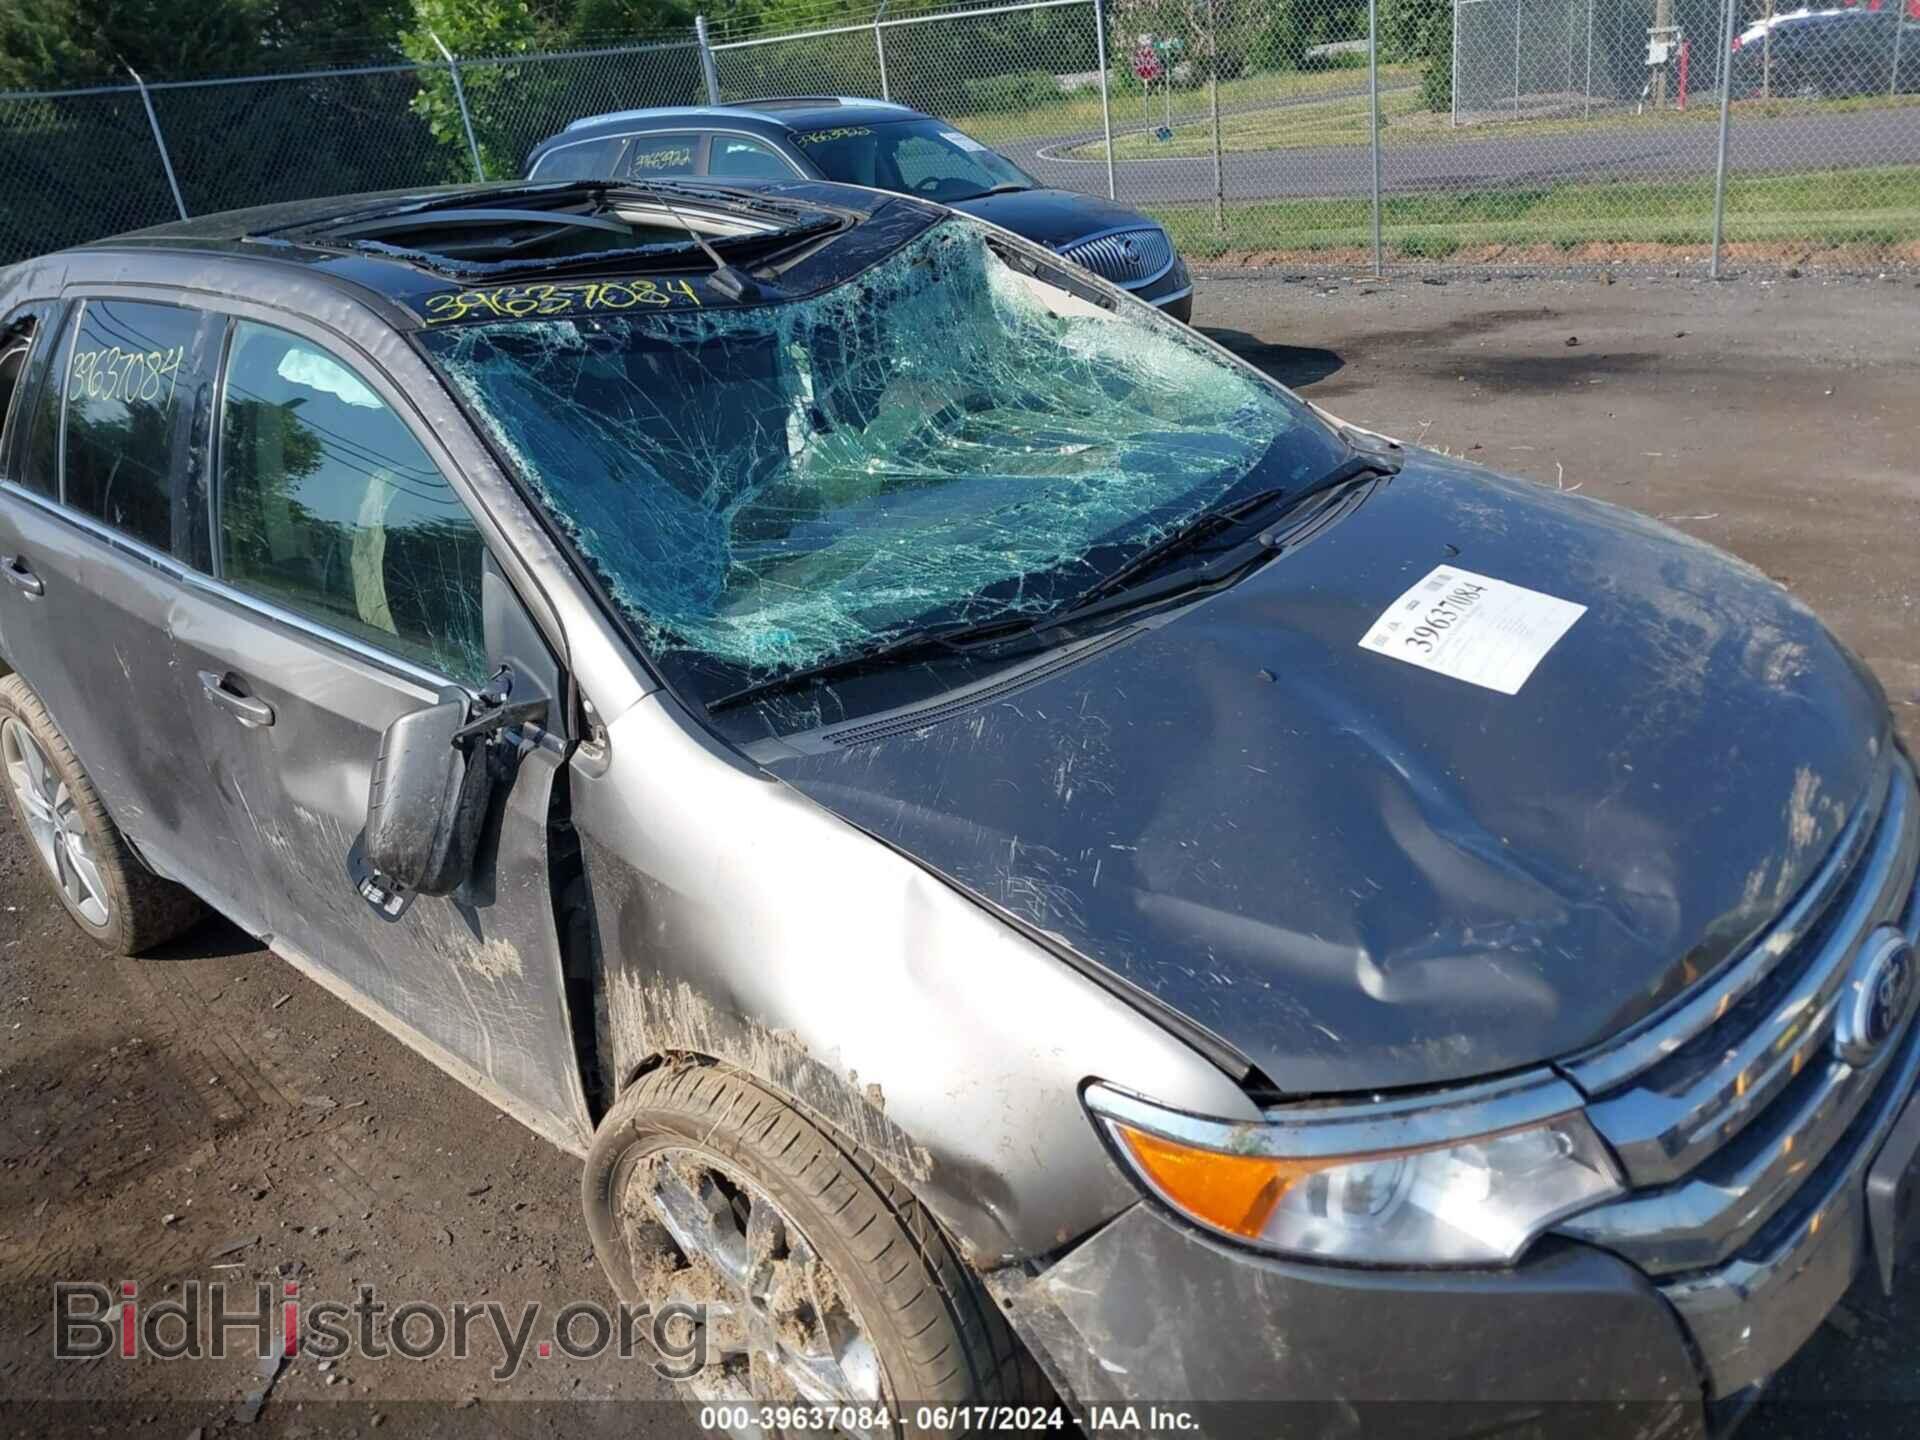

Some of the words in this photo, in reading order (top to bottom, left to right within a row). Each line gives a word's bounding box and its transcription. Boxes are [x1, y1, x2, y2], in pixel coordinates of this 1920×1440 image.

[426, 279, 701, 324] 39637084
[69, 345, 184, 411] 39637084
[1405, 581, 1489, 654] 39637084
